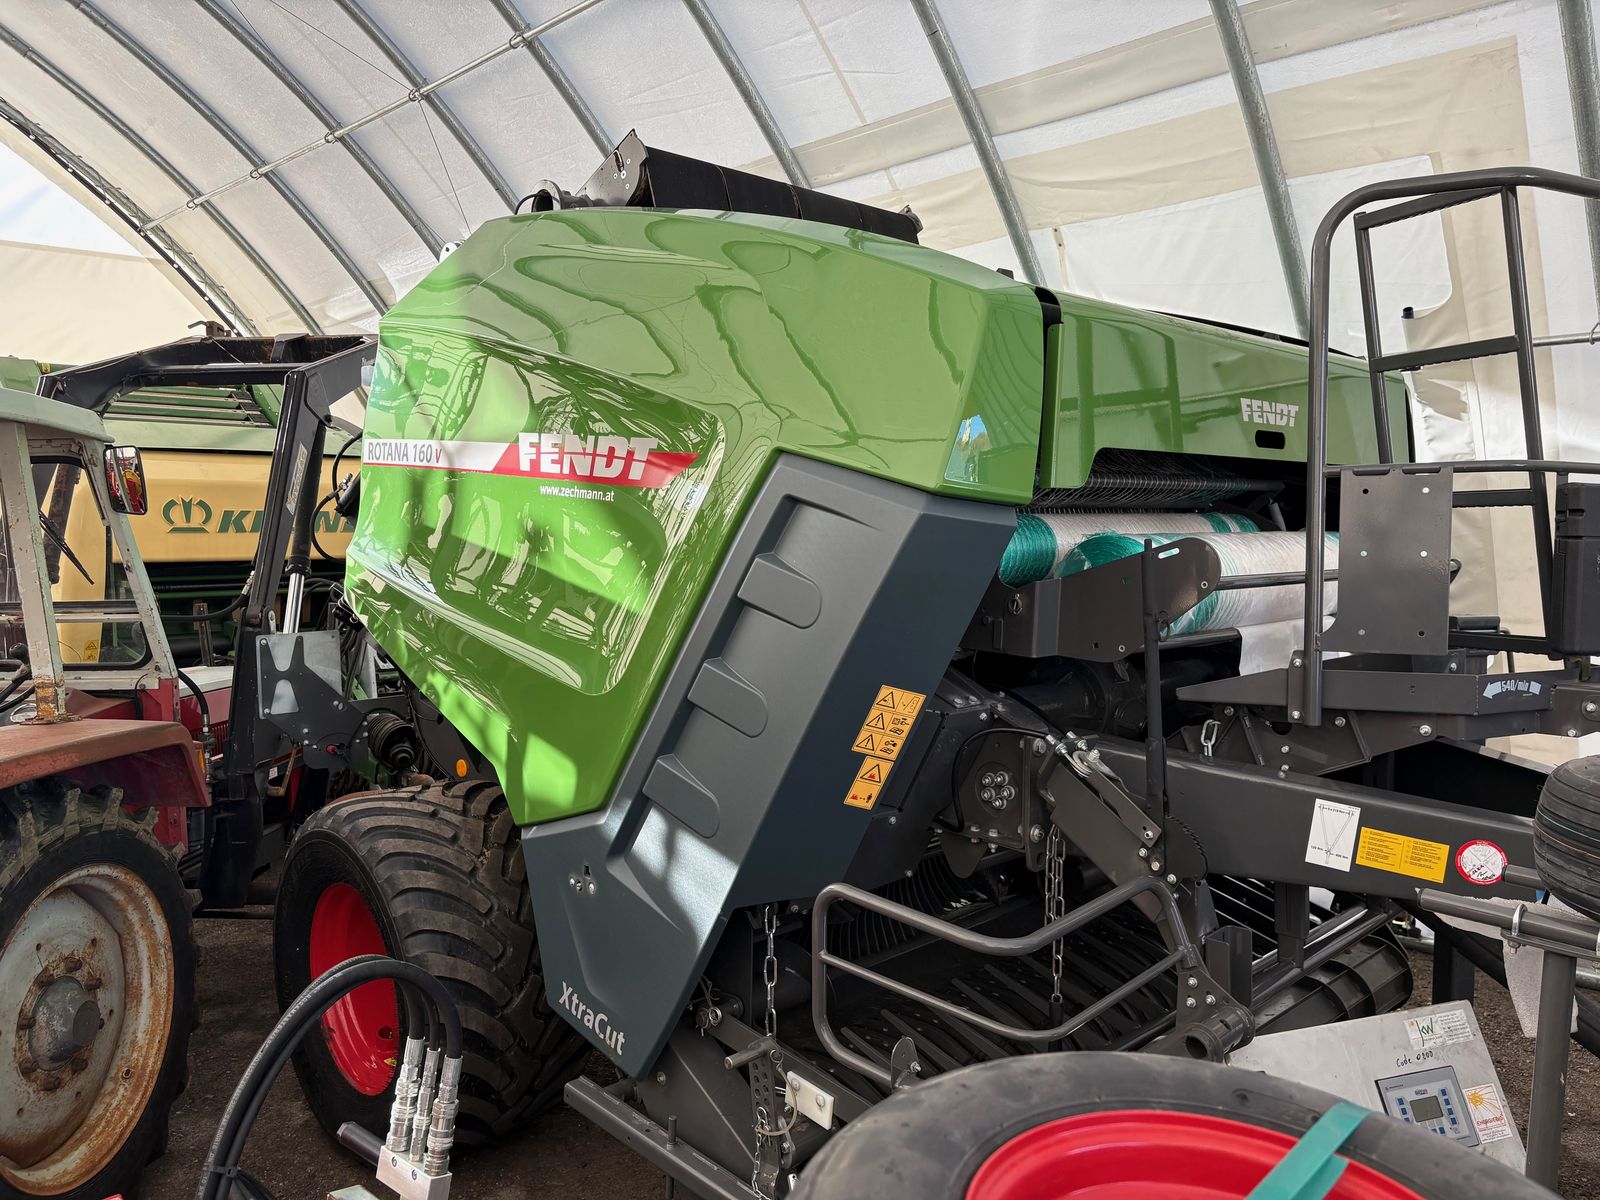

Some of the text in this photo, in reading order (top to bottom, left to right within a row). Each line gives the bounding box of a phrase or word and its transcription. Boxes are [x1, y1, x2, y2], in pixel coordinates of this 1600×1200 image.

[1240, 397, 1299, 427] FENDT
[367, 441, 409, 462] ROTANA
[413, 443, 433, 463] 160
[518, 432, 658, 481] FENDT
[540, 485, 615, 502] www.zechmann.at
[558, 980, 625, 1056] XtraCut
[1396, 1054, 1412, 1067] Code
